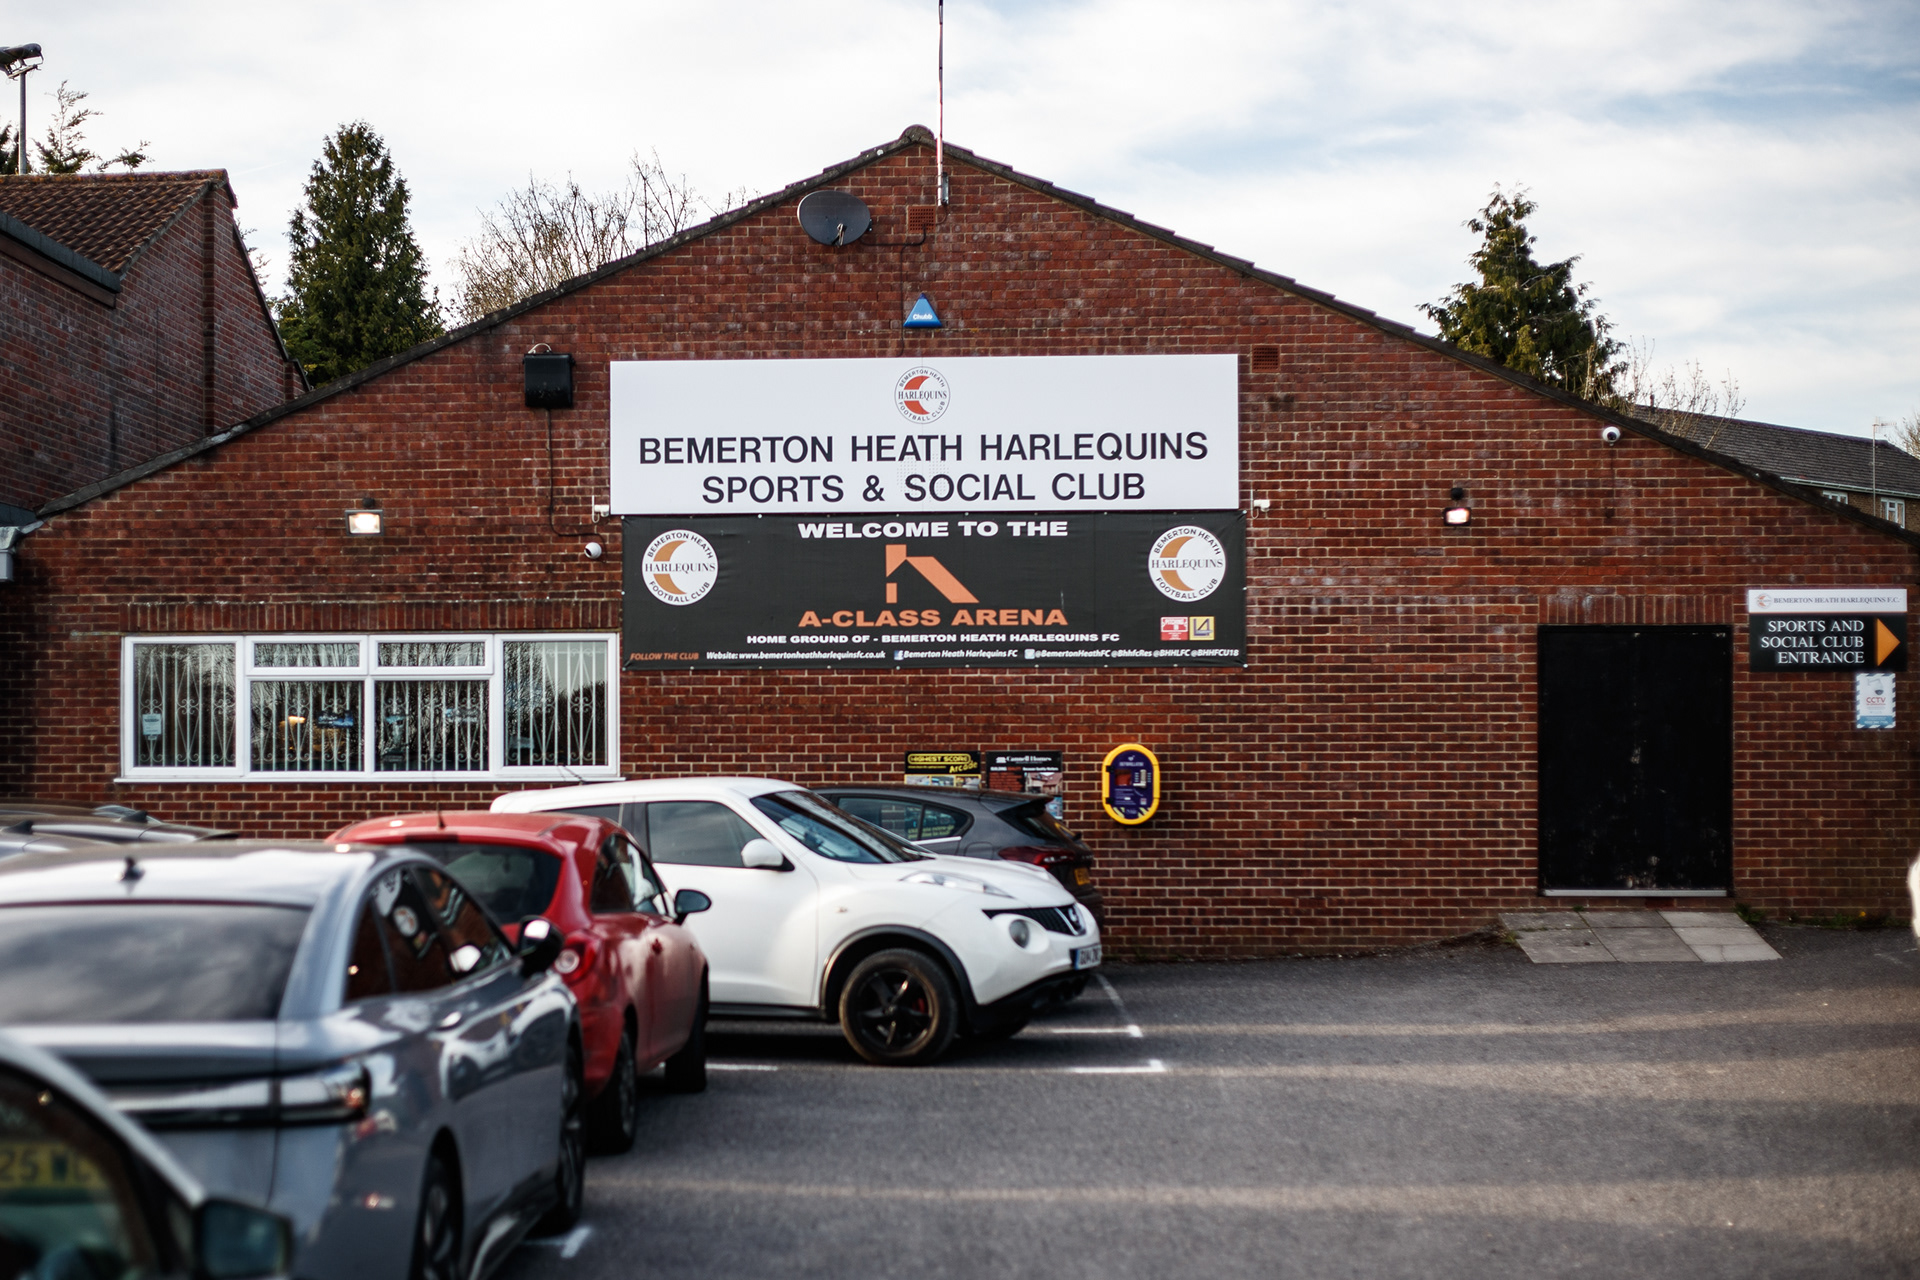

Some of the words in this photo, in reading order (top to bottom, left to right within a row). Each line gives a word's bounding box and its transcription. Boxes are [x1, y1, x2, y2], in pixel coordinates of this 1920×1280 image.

[899, 369, 929, 388] BEMERTON
[929, 371, 945, 388] HEATH
[898, 390, 948, 401] HARLEQUINS
[898, 401, 931, 422] FOOTBALL
[931, 401, 946, 418] CLUB
[639, 435, 833, 464] BEMERTON
[851, 434, 962, 462] HEATH
[980, 431, 1208, 462] HARLEQUINS
[702, 474, 844, 504] SPORTS
[862, 474, 885, 502] &
[904, 473, 1036, 502] SOCIAL
[1051, 472, 1146, 501] CLUB
[798, 522, 949, 539] WELCOME
[958, 521, 999, 537] TO
[1007, 521, 1068, 537] THE
[647, 532, 690, 558] BEMERTON
[690, 535, 714, 559] HEATH
[1153, 528, 1197, 554] BEMERTON
[1198, 530, 1221, 555] HEATH
[645, 563, 716, 574] HARLEQUINS
[1151, 559, 1224, 571] HARLEQUINS
[649, 580, 690, 603] FOOTBALL
[690, 581, 711, 600] CLUB
[1155, 577, 1198, 600] FOOTBALL
[1198, 578, 1219, 597] CLUB
[1840, 596, 1887, 604] HARLEQUINS
[798, 610, 942, 628] A-CLASS
[951, 609, 1069, 626] ARENA
[1768, 620, 1826, 633] SPORTS
[1831, 620, 1864, 632] AND
[746, 635, 787, 645] HOME
[790, 635, 849, 644] GROUND
[851, 635, 871, 644] OF
[881, 634, 957, 643] BEMERTON
[960, 634, 1007, 642] HEATH
[1009, 633, 1099, 643] HARLEQUINS
[1101, 633, 1120, 642] FC
[1761, 636, 1818, 648] SOCIAL
[1822, 636, 1864, 648] CLUB
[629, 653, 662, 662] FOLLOW
[663, 653, 678, 661] THE
[679, 652, 699, 661] CLUB
[706, 651, 739, 660] Website:
[739, 650, 886, 661] www.bemertonheathharlequinsfc.co.uk
[904, 651, 940, 659] Bemerton
[941, 650, 965, 658] Heath
[965, 650, 1007, 660] Harlequins
[1007, 649, 1018, 658] FC
[1778, 651, 1865, 664] ENTRANCE
[949, 760, 978, 773] Arcade
